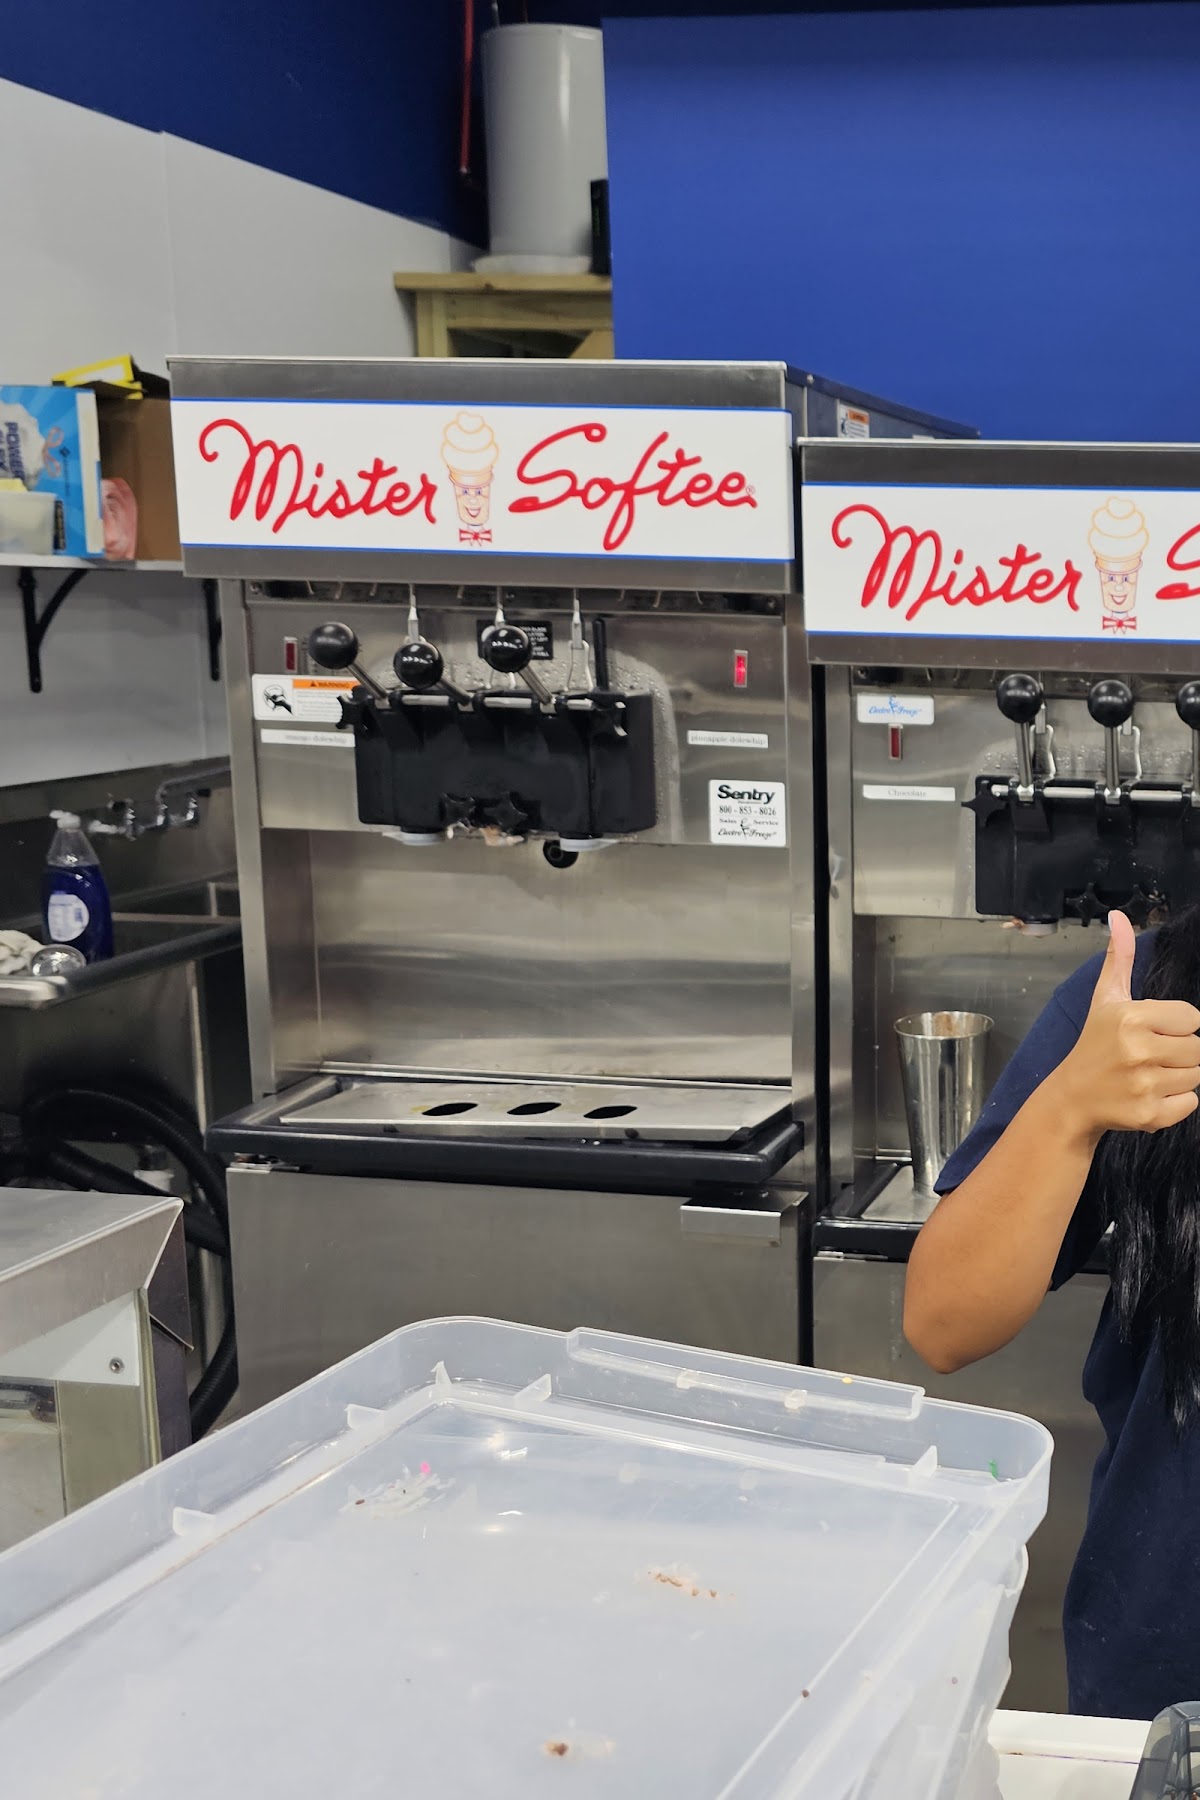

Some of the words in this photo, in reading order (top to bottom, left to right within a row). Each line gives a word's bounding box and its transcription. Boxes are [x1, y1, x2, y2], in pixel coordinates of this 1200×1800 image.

[199, 419, 437, 533] Mister
[832, 504, 1082, 621] Mister
[717, 784, 776, 805] Sentry
[888, 789, 927, 797] Chocolate
[719, 805, 733, 814] 800
[739, 806, 753, 815] 853
[759, 807, 777, 816] 8026
